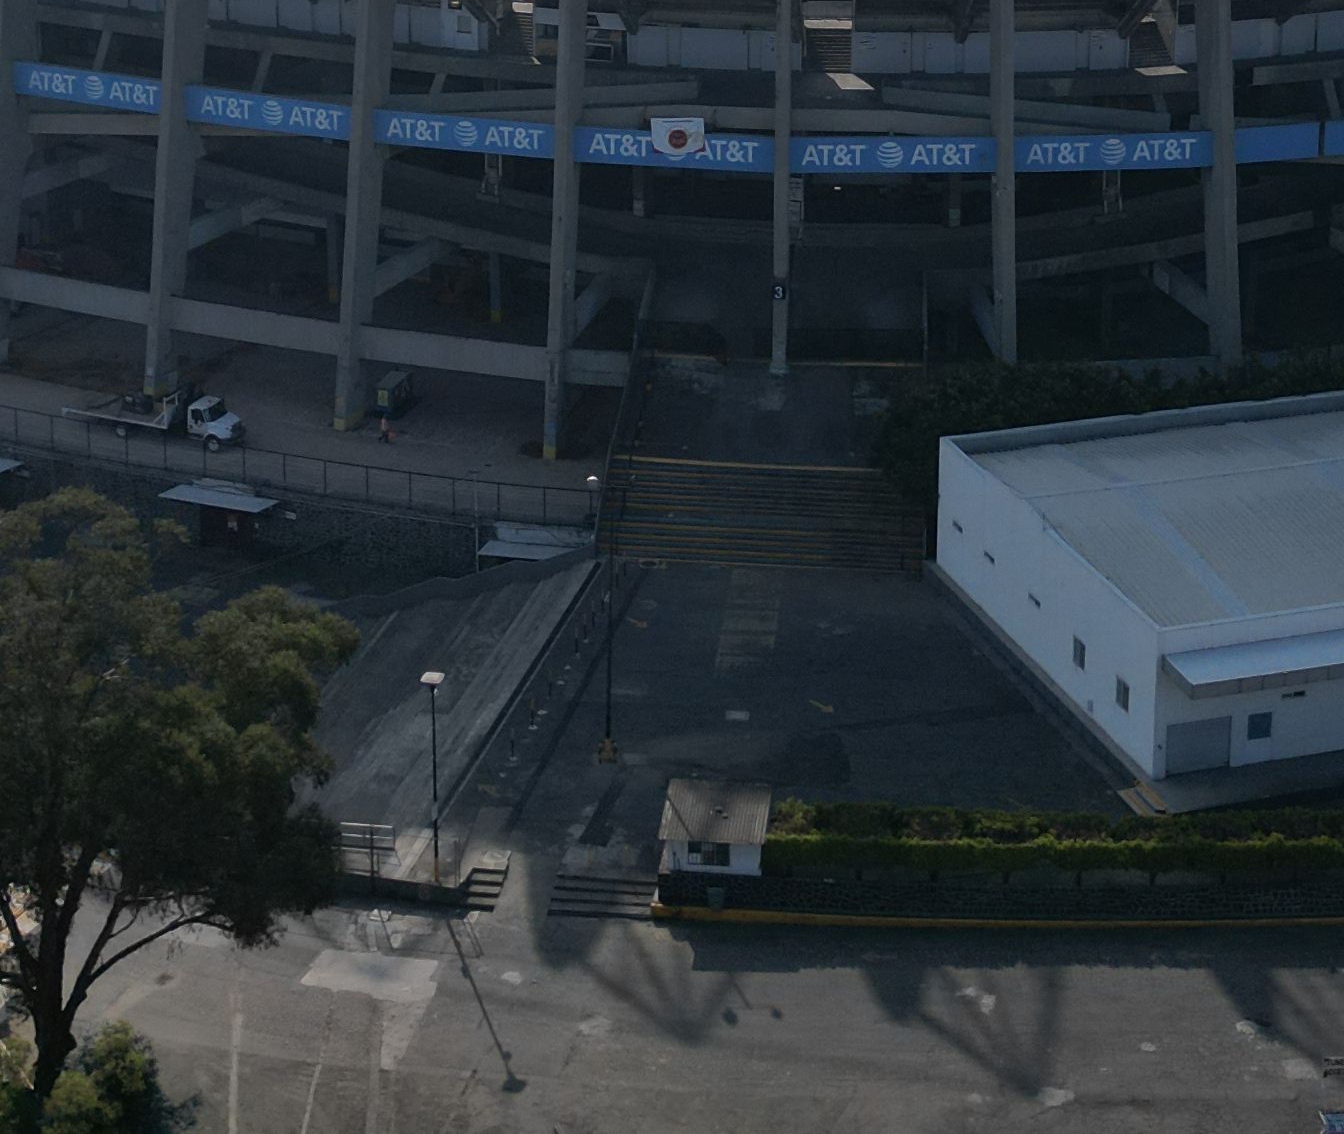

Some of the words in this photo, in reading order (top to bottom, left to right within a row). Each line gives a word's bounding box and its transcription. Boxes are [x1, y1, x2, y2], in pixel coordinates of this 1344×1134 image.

[28, 70, 77, 95] AT&T
[109, 81, 158, 106] AT&T
[201, 96, 253, 120] AT&T
[288, 106, 343, 131] AT&T
[387, 118, 445, 142] AT&T
[483, 126, 544, 151] AT&T
[589, 132, 653, 158] AT&T
[695, 139, 760, 164] AT&T
[801, 144, 867, 167] AT&T
[910, 143, 976, 167] AT&T
[1026, 142, 1092, 165] AT&T
[1132, 138, 1199, 162] AT&T
[774, 285, 783, 299] 3
